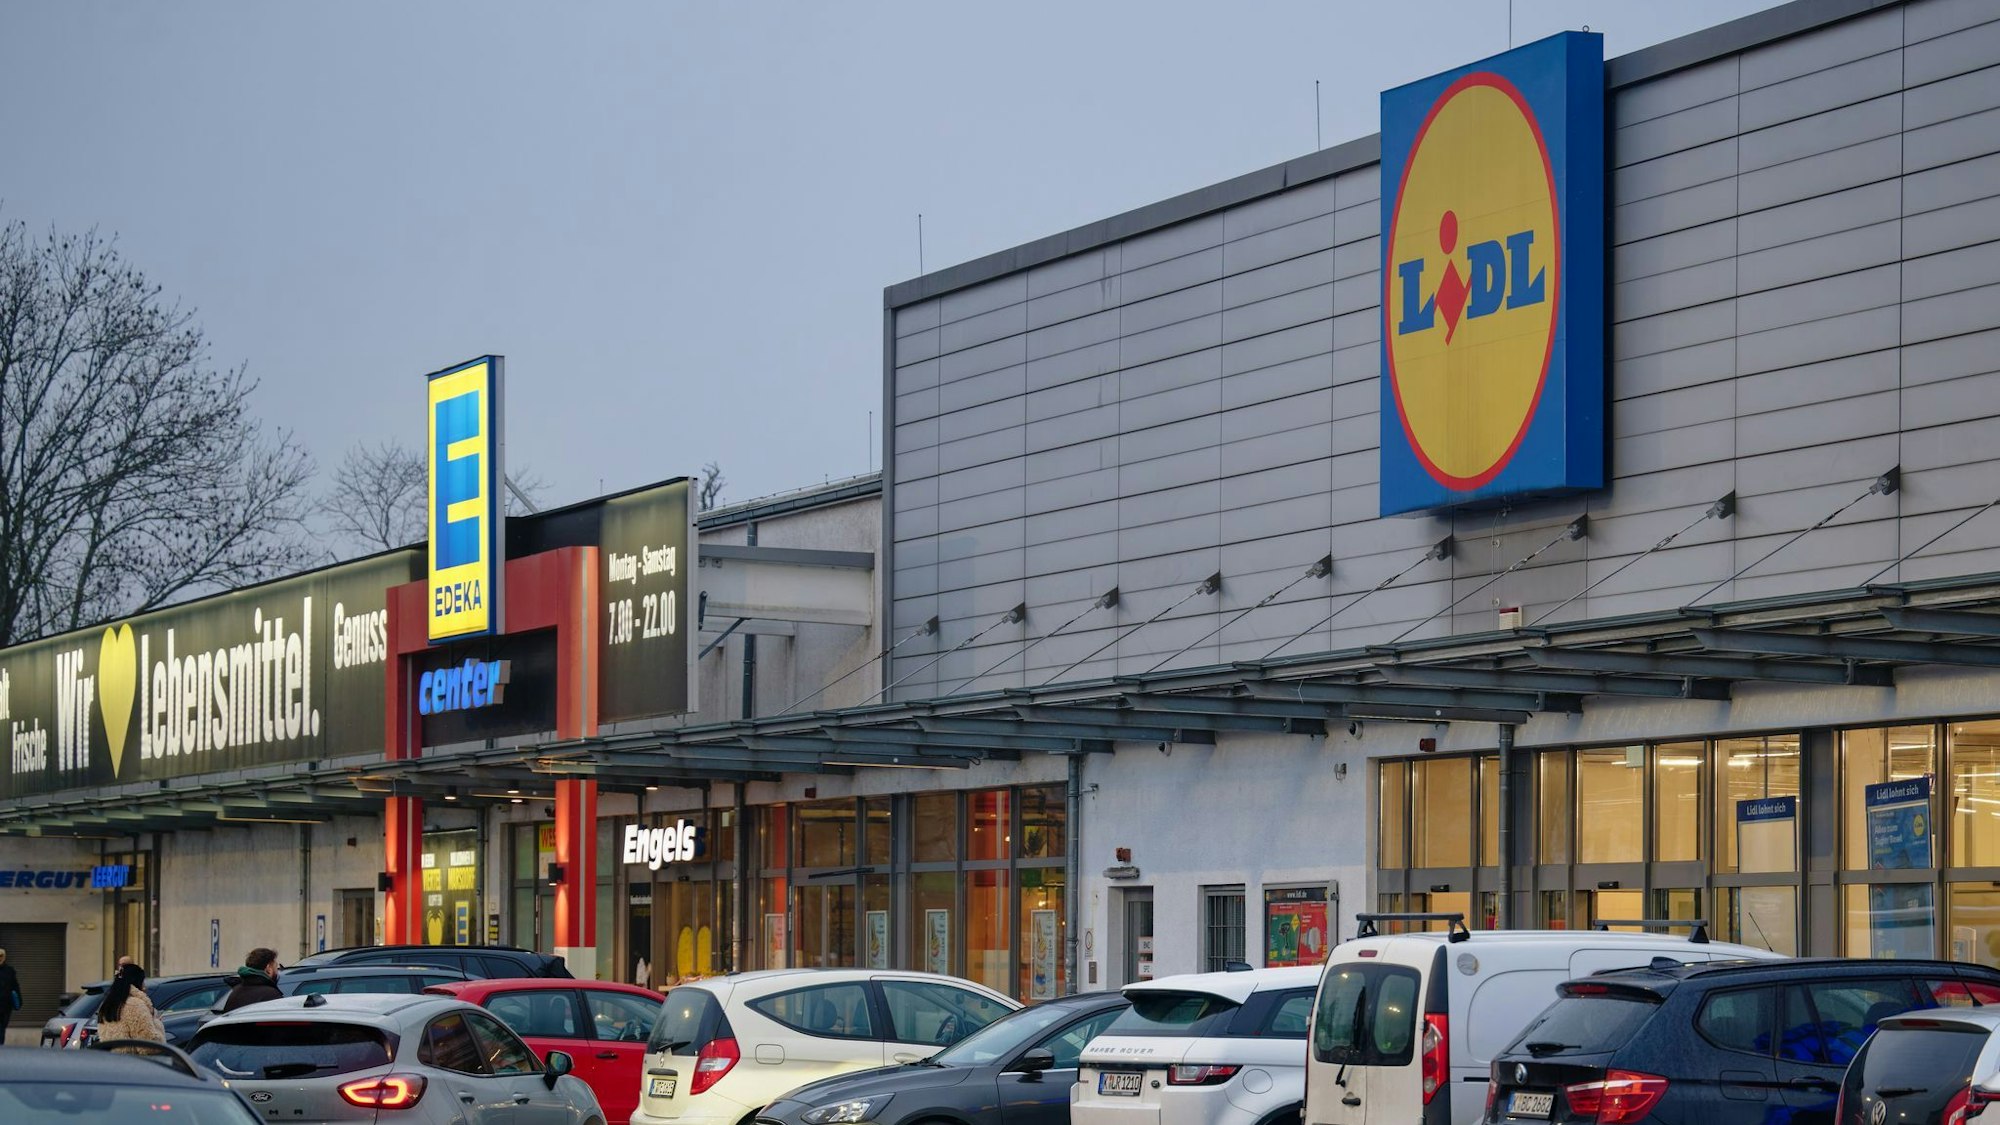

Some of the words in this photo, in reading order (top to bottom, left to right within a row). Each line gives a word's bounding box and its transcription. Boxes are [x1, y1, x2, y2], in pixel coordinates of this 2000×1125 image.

[1399, 210, 1545, 346] LIDL
[609, 553, 637, 585] Montag
[642, 544, 676, 577] Samstag
[436, 580, 482, 616] EDEKA
[608, 598, 633, 645] 7.00
[634, 618, 640, 627] -
[642, 590, 675, 638] 22.00
[334, 602, 387, 670] Genuss
[56, 648, 94, 771] Wir
[141, 597, 320, 760] Lebensmittel.
[419, 657, 501, 715] center
[12, 717, 47, 774] Frische
[1747, 804, 1758, 816] Lidl
[1758, 803, 1774, 815] lohnt
[1774, 802, 1786, 813] sich
[1876, 788, 1889, 800] Lidl
[1889, 786, 1906, 798] lohnt
[1906, 784, 1919, 796] sich
[623, 818, 696, 871] Engels
[92, 865, 128, 888] LEERGUT
[1122, 1076, 1140, 1091] 1210
